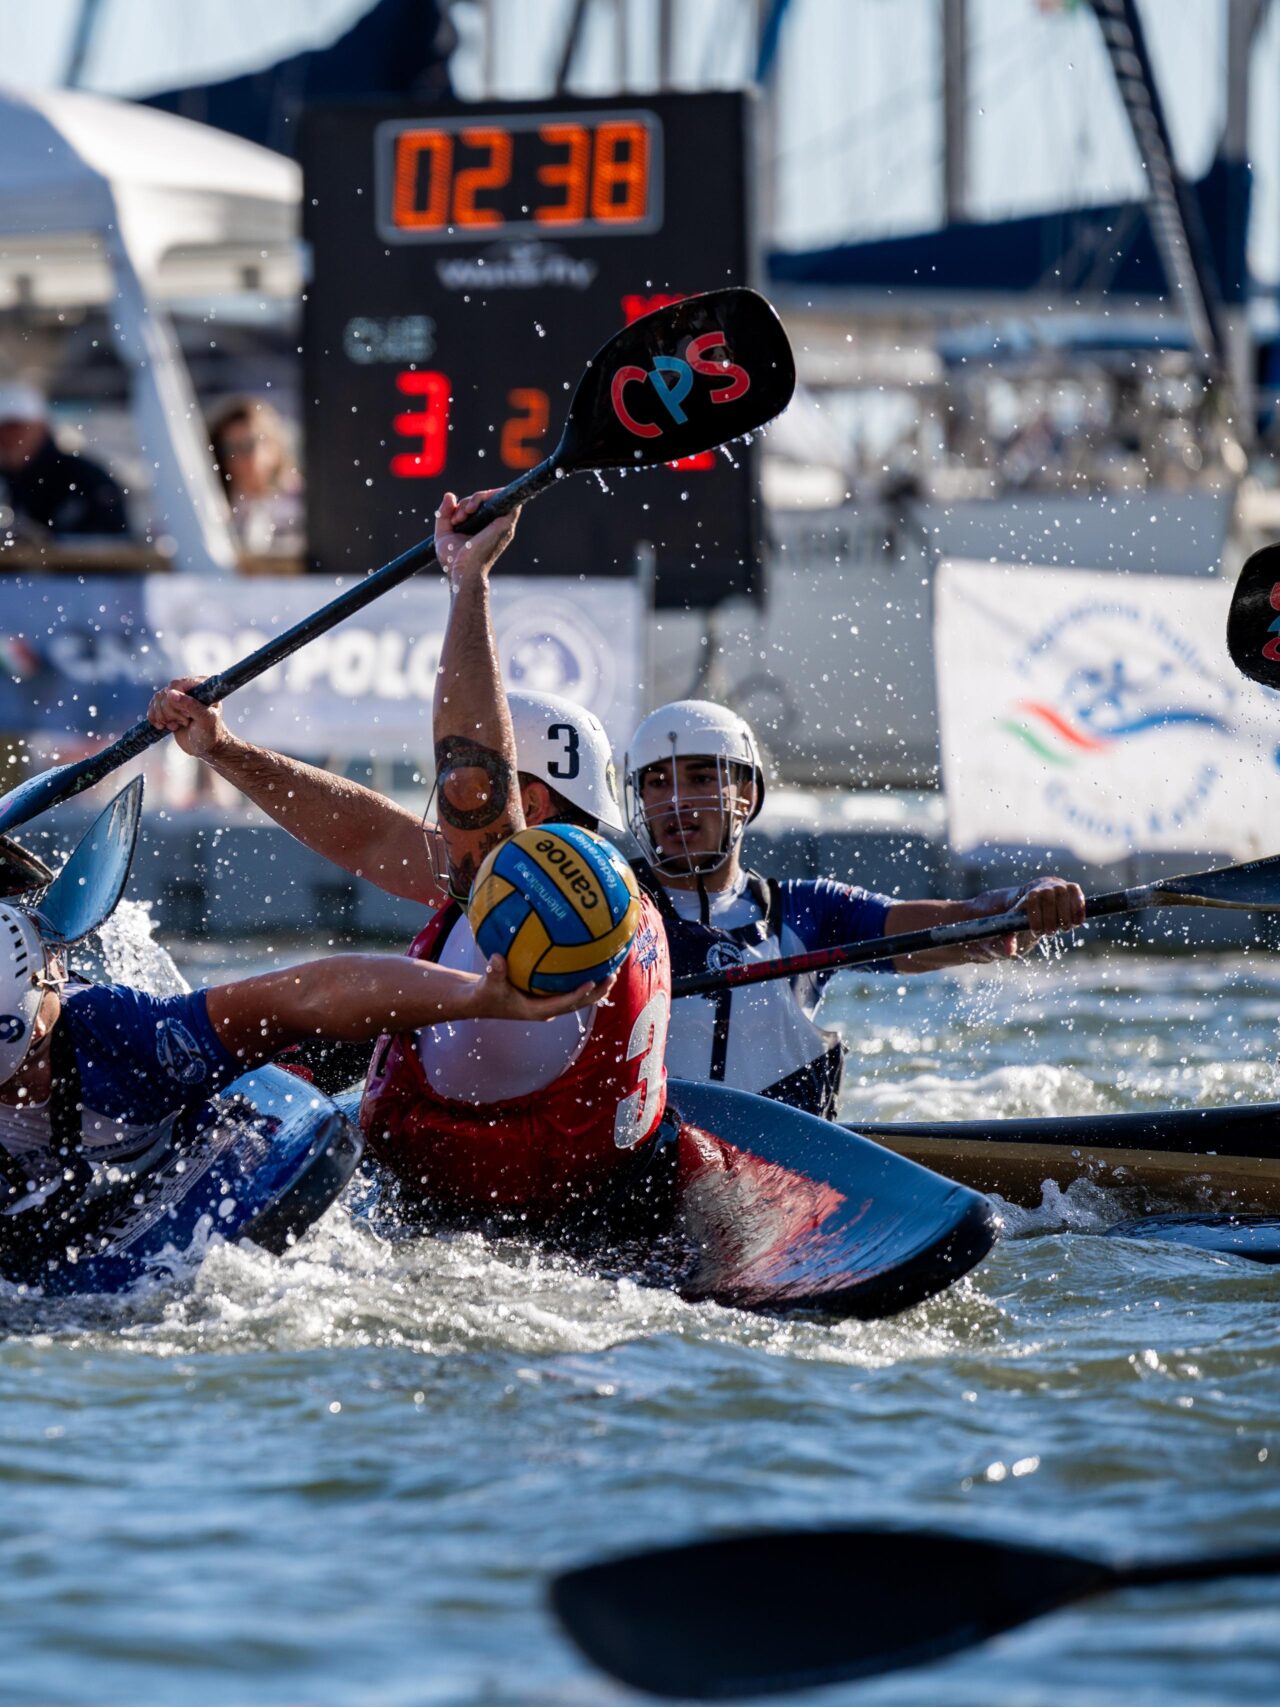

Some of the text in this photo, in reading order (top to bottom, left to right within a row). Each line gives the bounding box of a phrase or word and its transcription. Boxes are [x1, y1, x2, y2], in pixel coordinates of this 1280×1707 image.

[389, 370, 452, 478] 3
[611, 331, 751, 438] CPS
[501, 388, 550, 469] 2
[546, 723, 580, 780] 3
[512, 860, 569, 923] international
[534, 838, 599, 910] canoe
[613, 990, 668, 1149] 3
